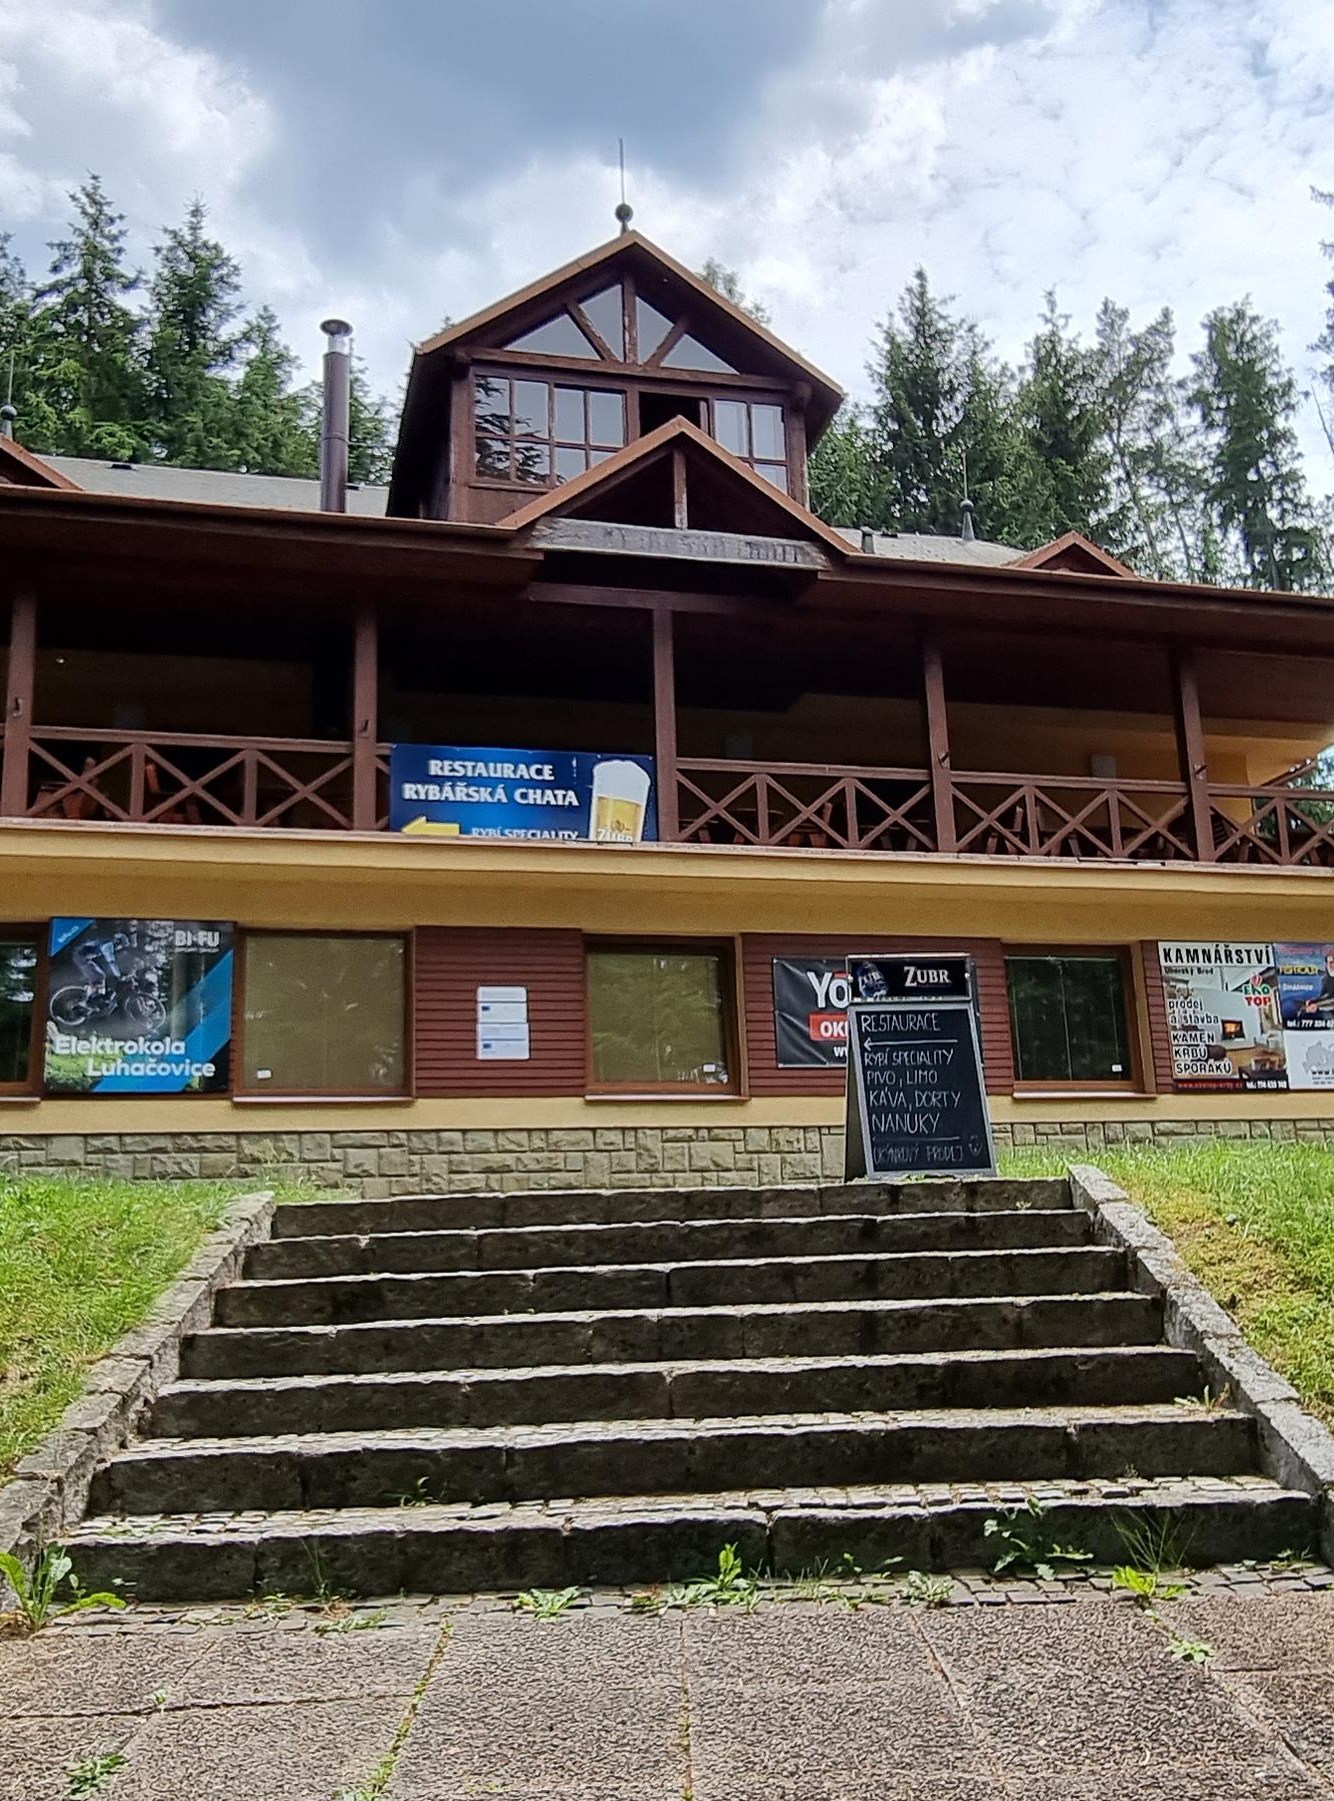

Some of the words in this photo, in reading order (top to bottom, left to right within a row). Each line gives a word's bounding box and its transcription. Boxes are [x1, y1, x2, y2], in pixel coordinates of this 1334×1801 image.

[428, 759, 554, 781] RESTAURACE
[402, 782, 508, 804] RYBÁŘSKÁ
[514, 788, 579, 807] CHATA
[472, 827, 503, 837] RYBÍ
[1163, 944, 1271, 965] KAMNÁŘSTVÍ
[1244, 984, 1271, 996] EKO
[1169, 998, 1203, 1011] prodej
[1245, 996, 1272, 1007] TOP
[861, 1012, 941, 1033] RESTAURACE
[1183, 1013, 1219, 1024] stavba
[56, 1036, 185, 1055] Elektrokola
[892, 1049, 954, 1066] SPECIALITY
[87, 1057, 216, 1077] Luhačovice
[907, 1069, 938, 1084] LIMO
[916, 1091, 961, 1109] DORTY
